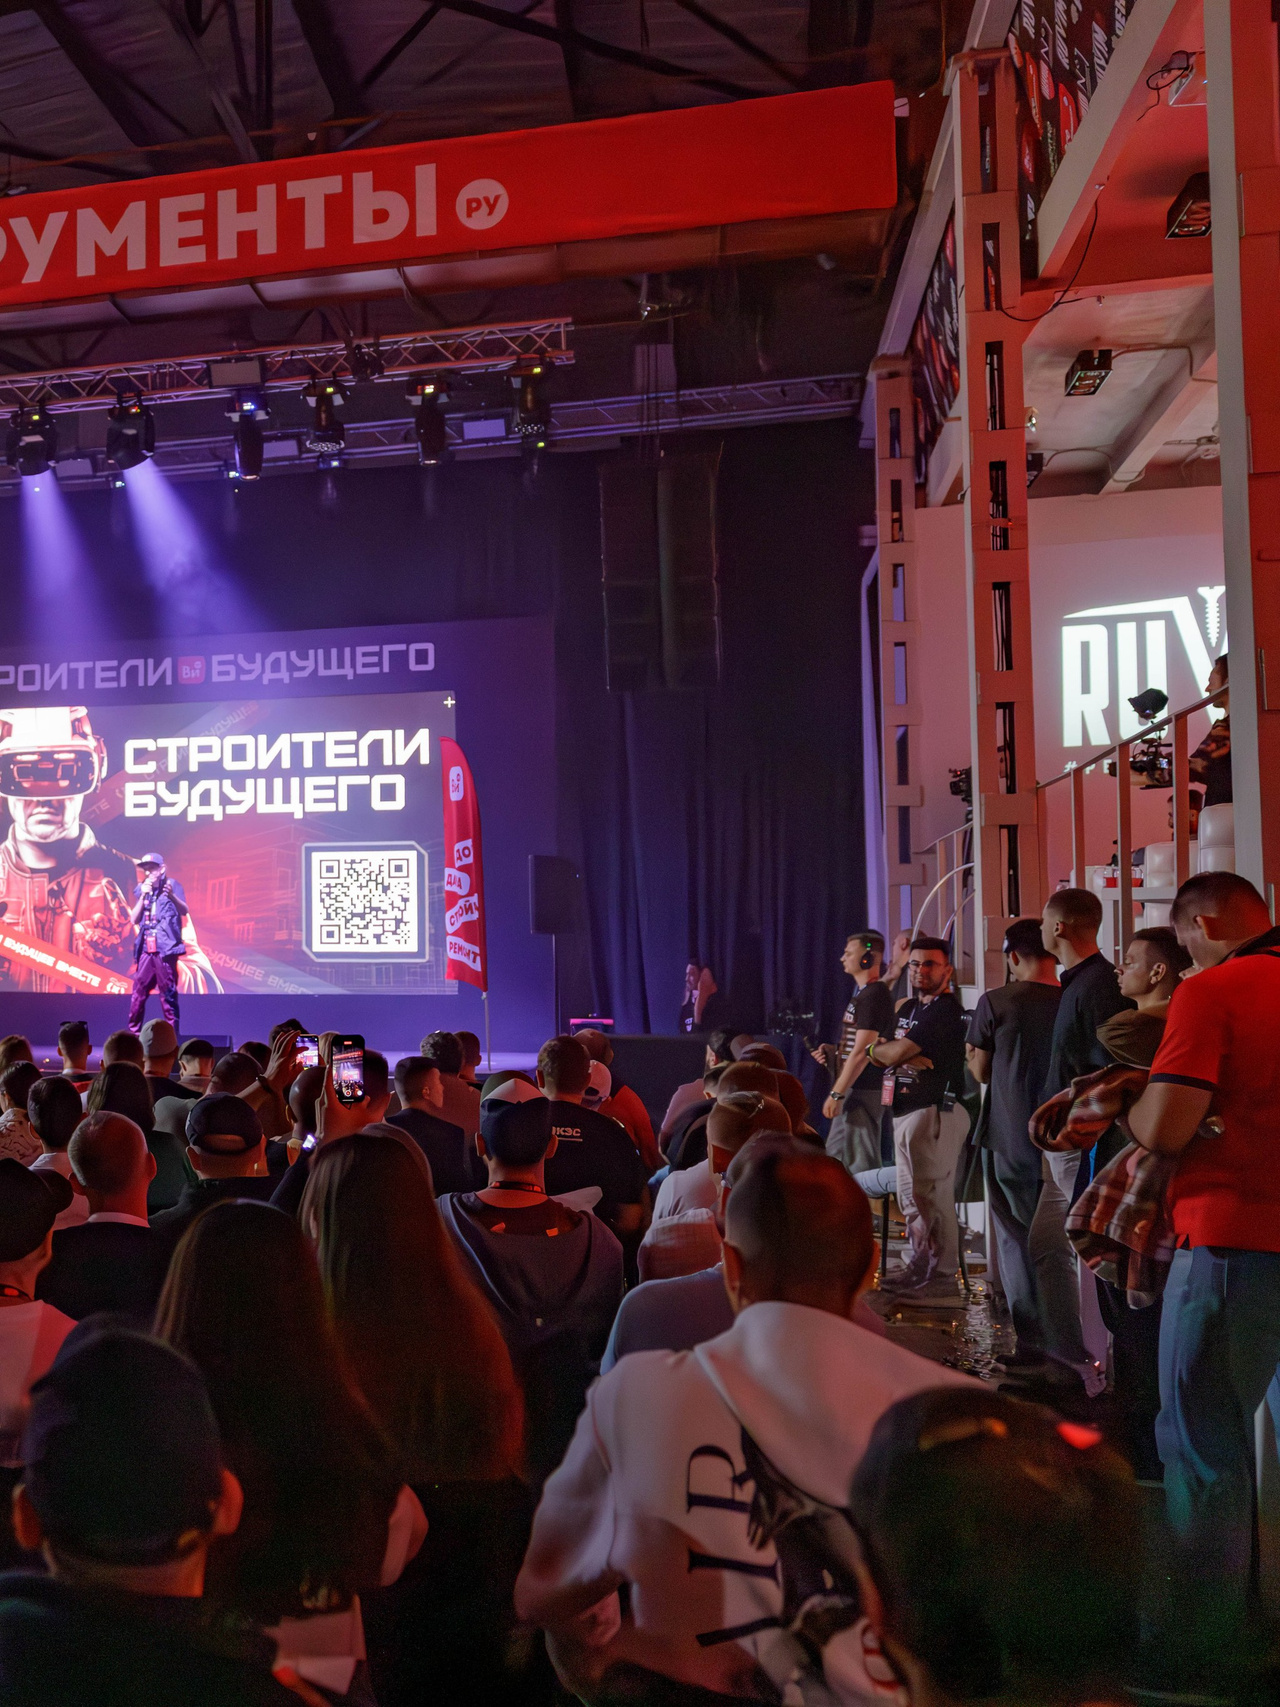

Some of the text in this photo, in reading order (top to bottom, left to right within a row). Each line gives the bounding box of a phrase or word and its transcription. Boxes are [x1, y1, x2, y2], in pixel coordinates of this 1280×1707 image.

[211, 642, 435, 684] БУДУЩЕГО
[124, 728, 430, 775] СТРОИТЕЛИ
[124, 774, 407, 822] БУДУЩЕГО
